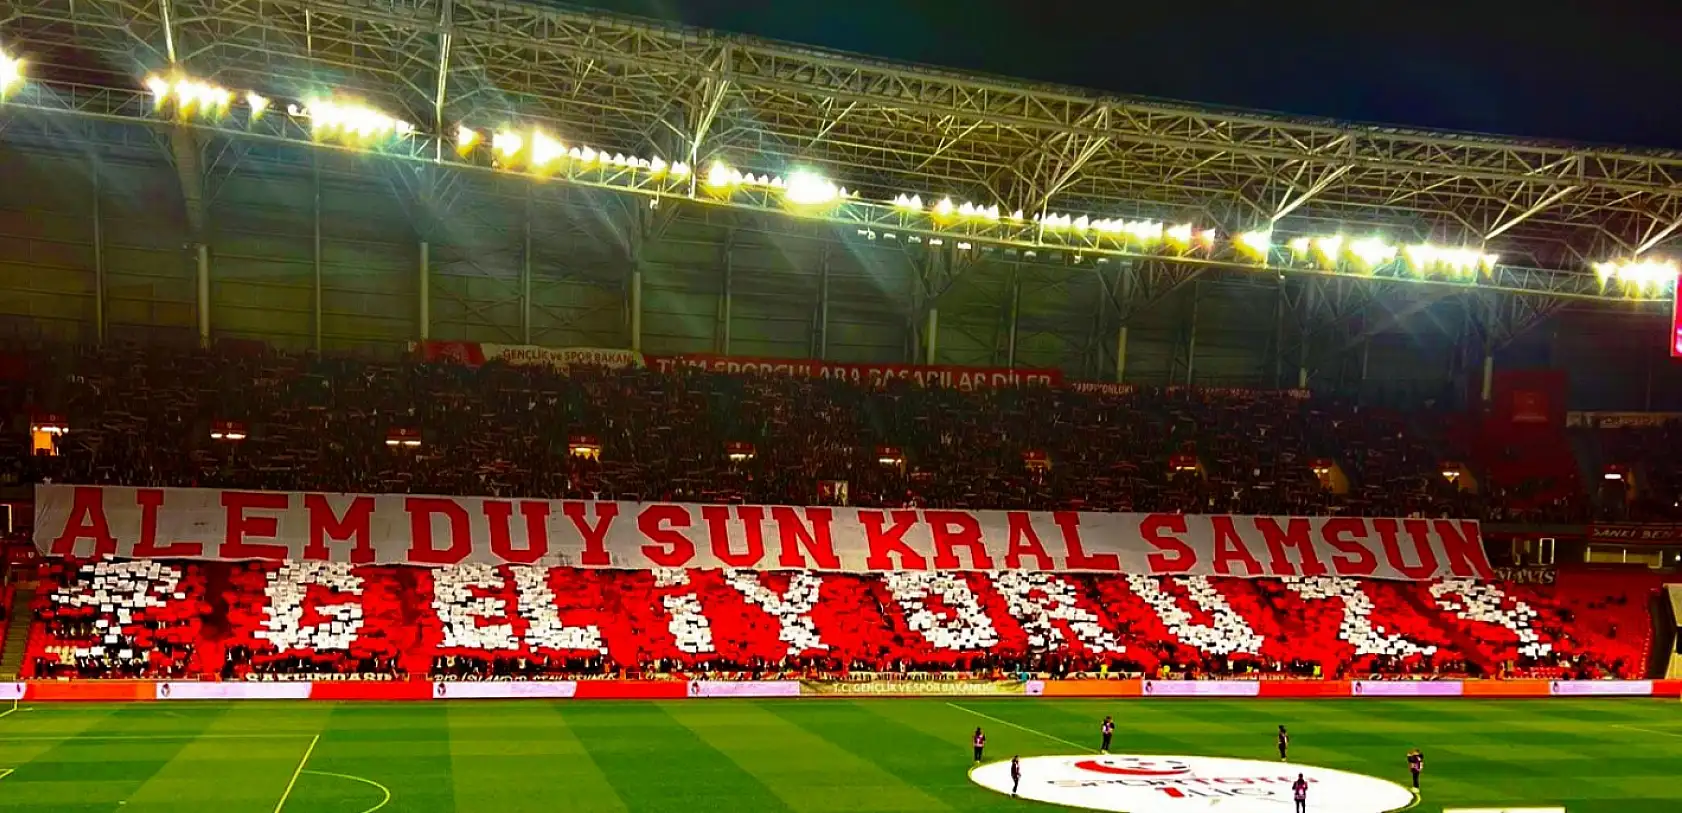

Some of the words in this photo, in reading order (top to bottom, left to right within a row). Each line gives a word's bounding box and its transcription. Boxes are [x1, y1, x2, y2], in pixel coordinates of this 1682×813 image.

[50, 486, 376, 564] ALEM
[404, 498, 840, 570] DUYSUN
[858, 509, 1120, 571] KRAL
[1139, 513, 1495, 580] SAMSUN
